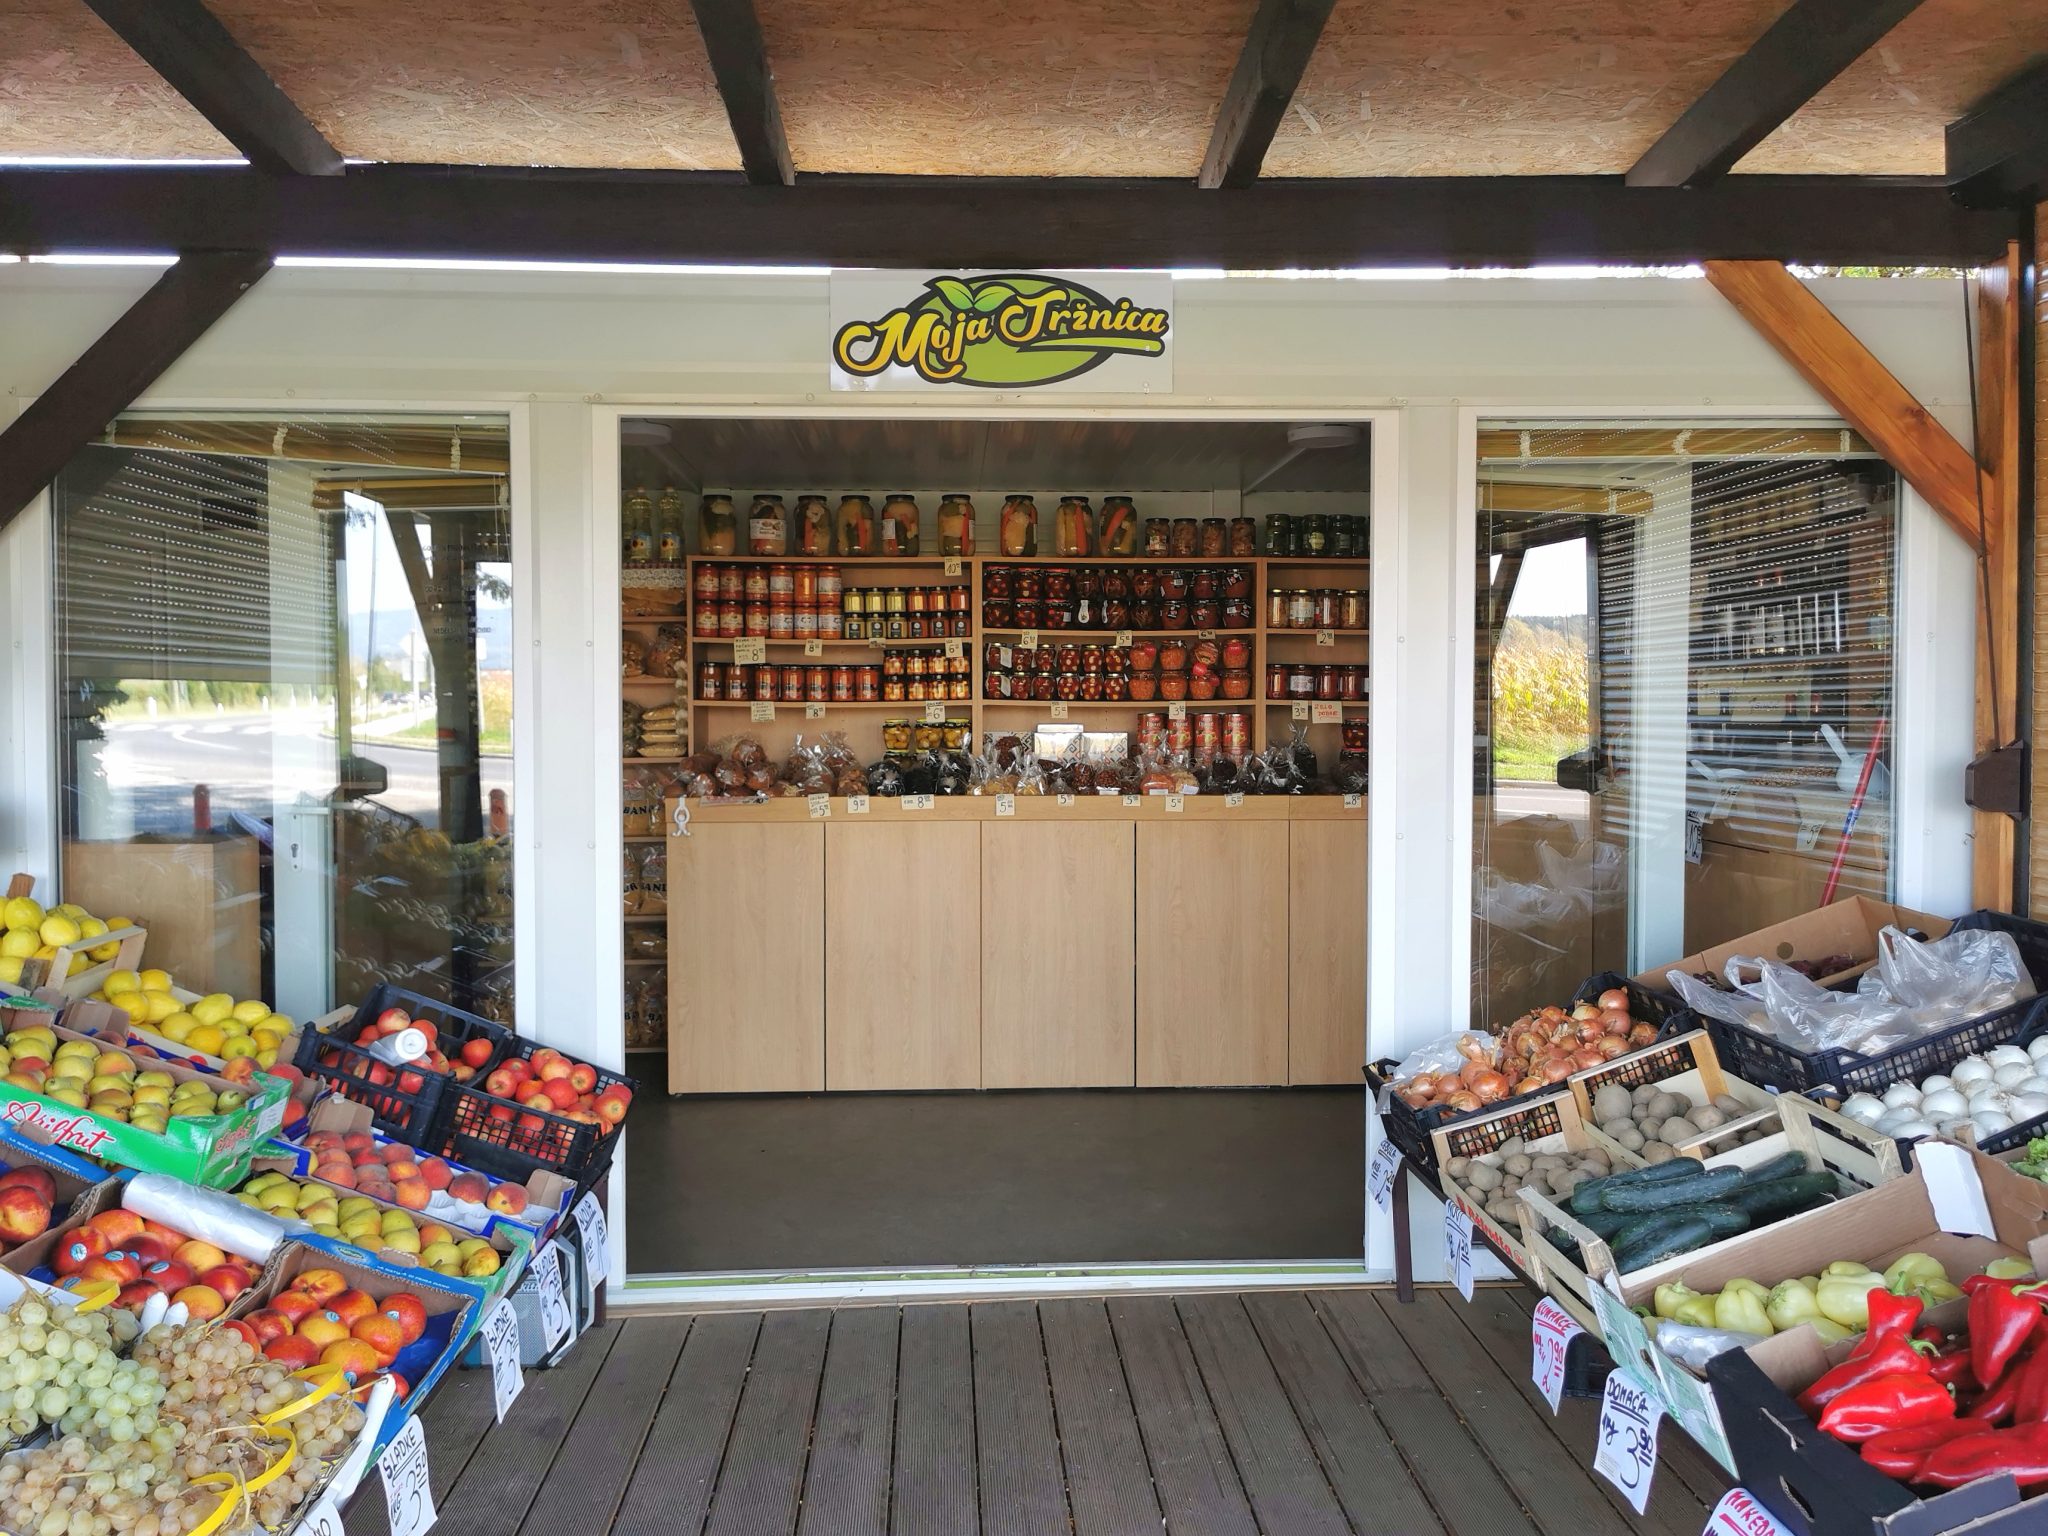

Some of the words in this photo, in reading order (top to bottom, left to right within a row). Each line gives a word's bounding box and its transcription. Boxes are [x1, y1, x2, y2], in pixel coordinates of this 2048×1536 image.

[839, 311, 991, 380] Moja
[999, 289, 1167, 343] Tržnica
[382, 1426, 418, 1480] SLADKE
